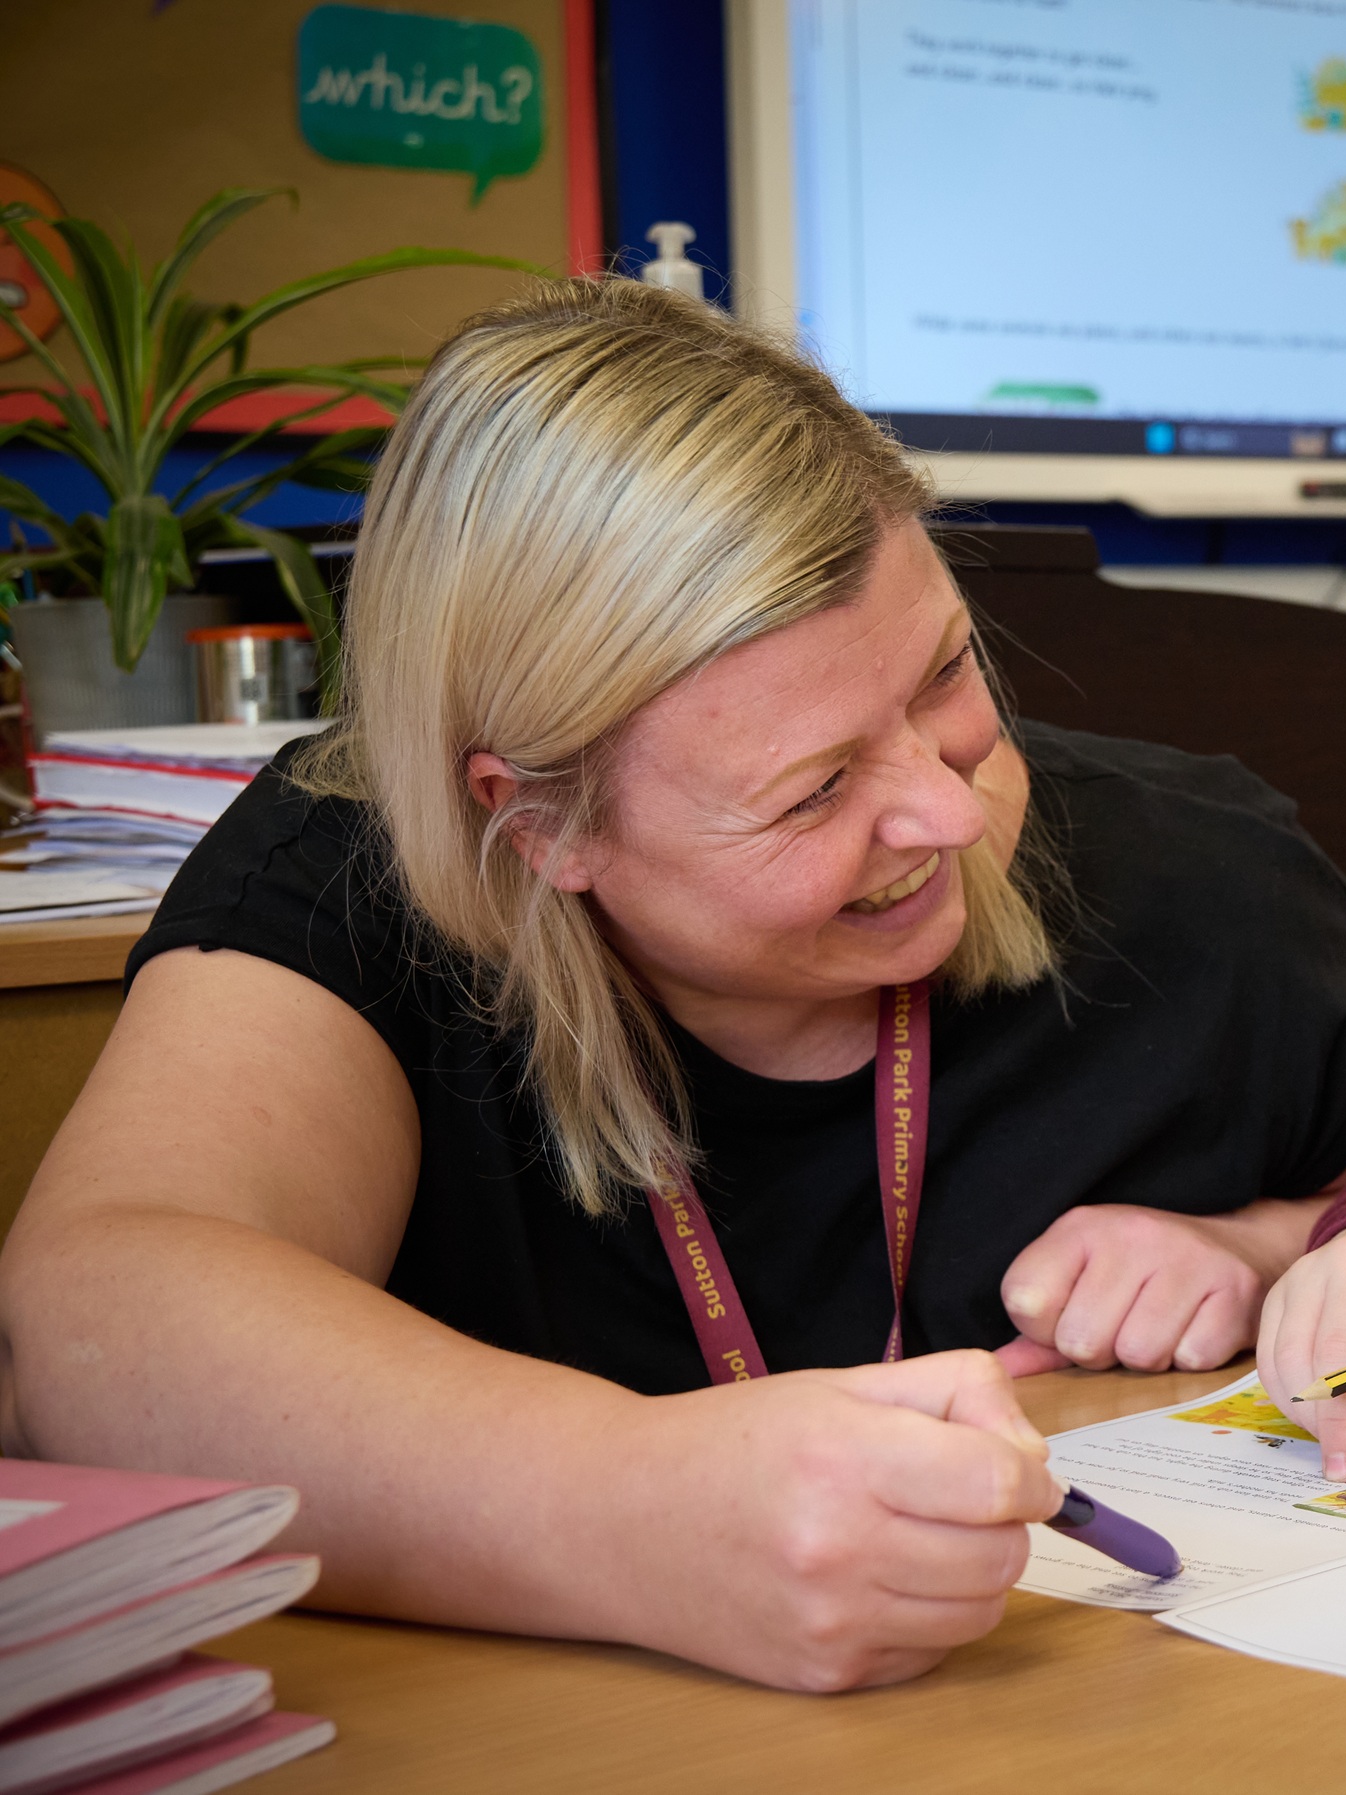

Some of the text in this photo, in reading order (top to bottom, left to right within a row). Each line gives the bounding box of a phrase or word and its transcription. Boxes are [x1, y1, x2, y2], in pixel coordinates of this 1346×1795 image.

[304, 52, 534, 125] which?
[895, 983, 912, 1043] utton
[893, 1048, 913, 1101] Park
[892, 1107, 914, 1201] Primary
[664, 1187, 695, 1239] Park
[686, 1240, 727, 1320] Sutton
[722, 1348, 751, 1383] ool
